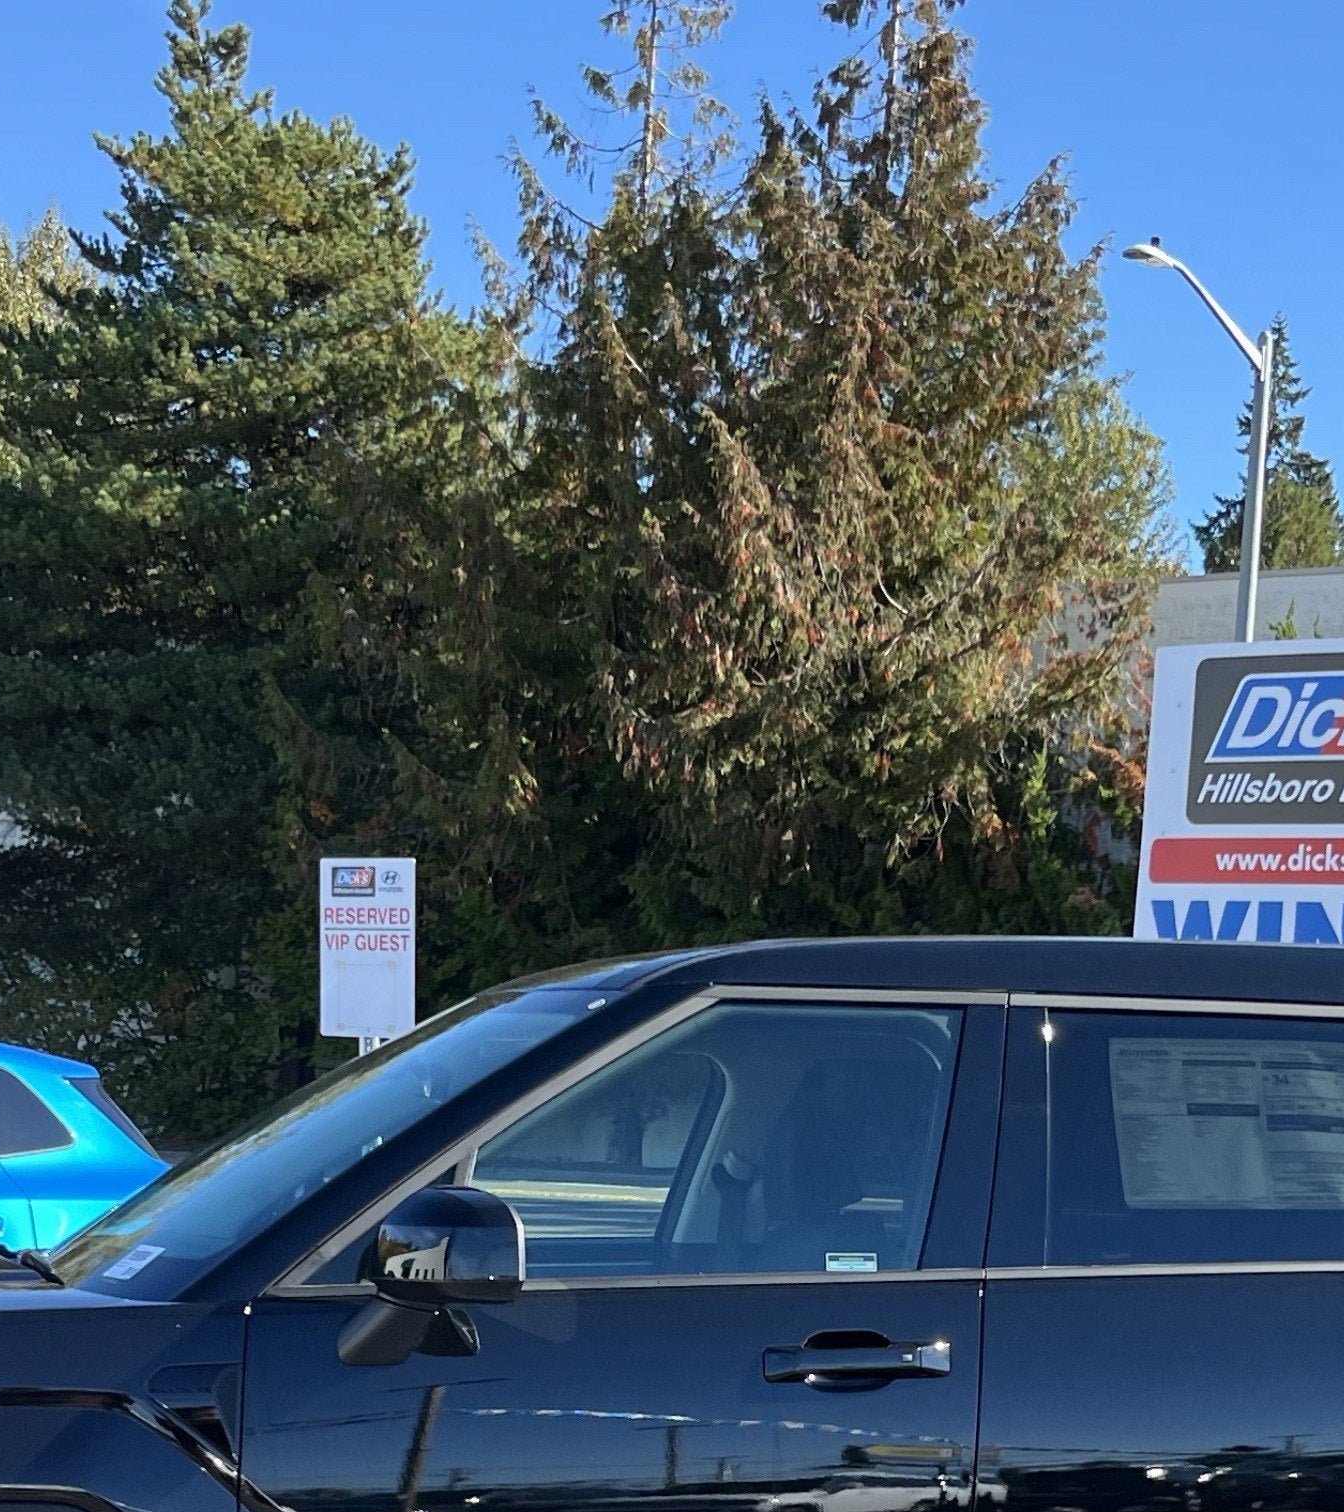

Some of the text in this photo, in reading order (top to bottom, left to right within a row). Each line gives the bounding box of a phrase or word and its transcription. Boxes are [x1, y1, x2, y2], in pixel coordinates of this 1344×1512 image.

[1197, 772, 1334, 804] Hillsboro
[324, 907, 410, 925] RESERVED
[325, 933, 410, 951] VIP GUEST
